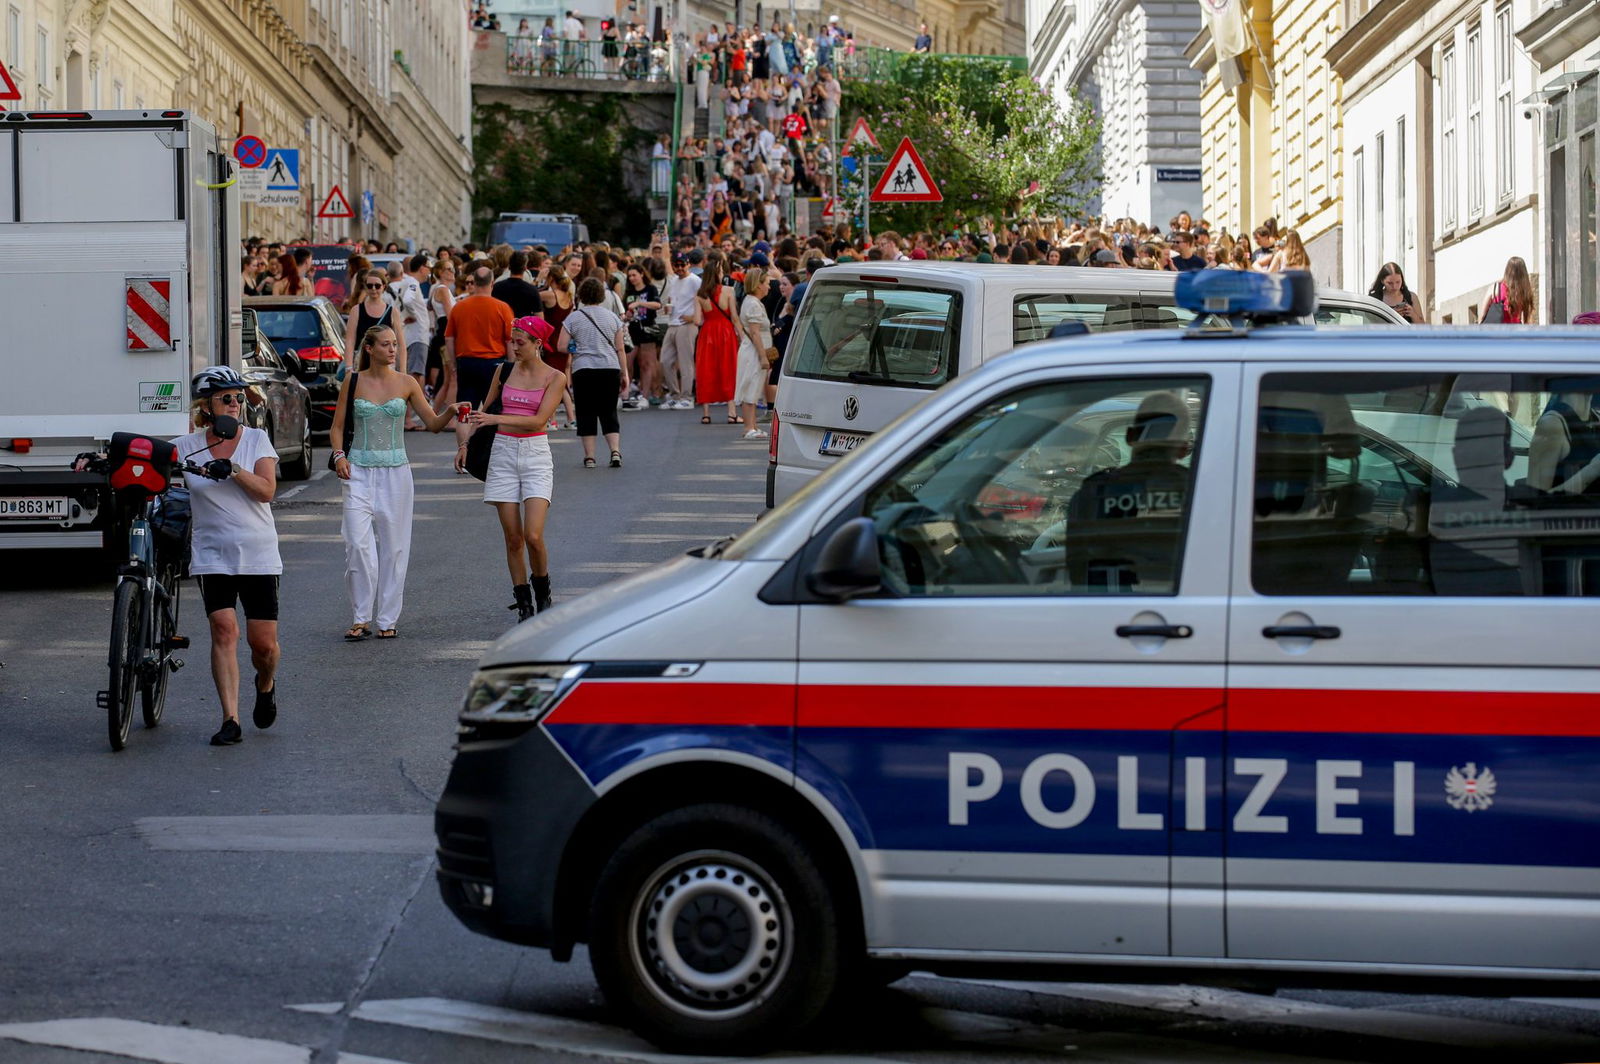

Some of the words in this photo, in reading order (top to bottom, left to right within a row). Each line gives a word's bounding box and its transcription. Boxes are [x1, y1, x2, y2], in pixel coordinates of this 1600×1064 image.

[831, 434, 840, 448] W
[18, 500, 43, 513] 863
[45, 500, 62, 513] MT
[948, 751, 1415, 836] POLIZEI
